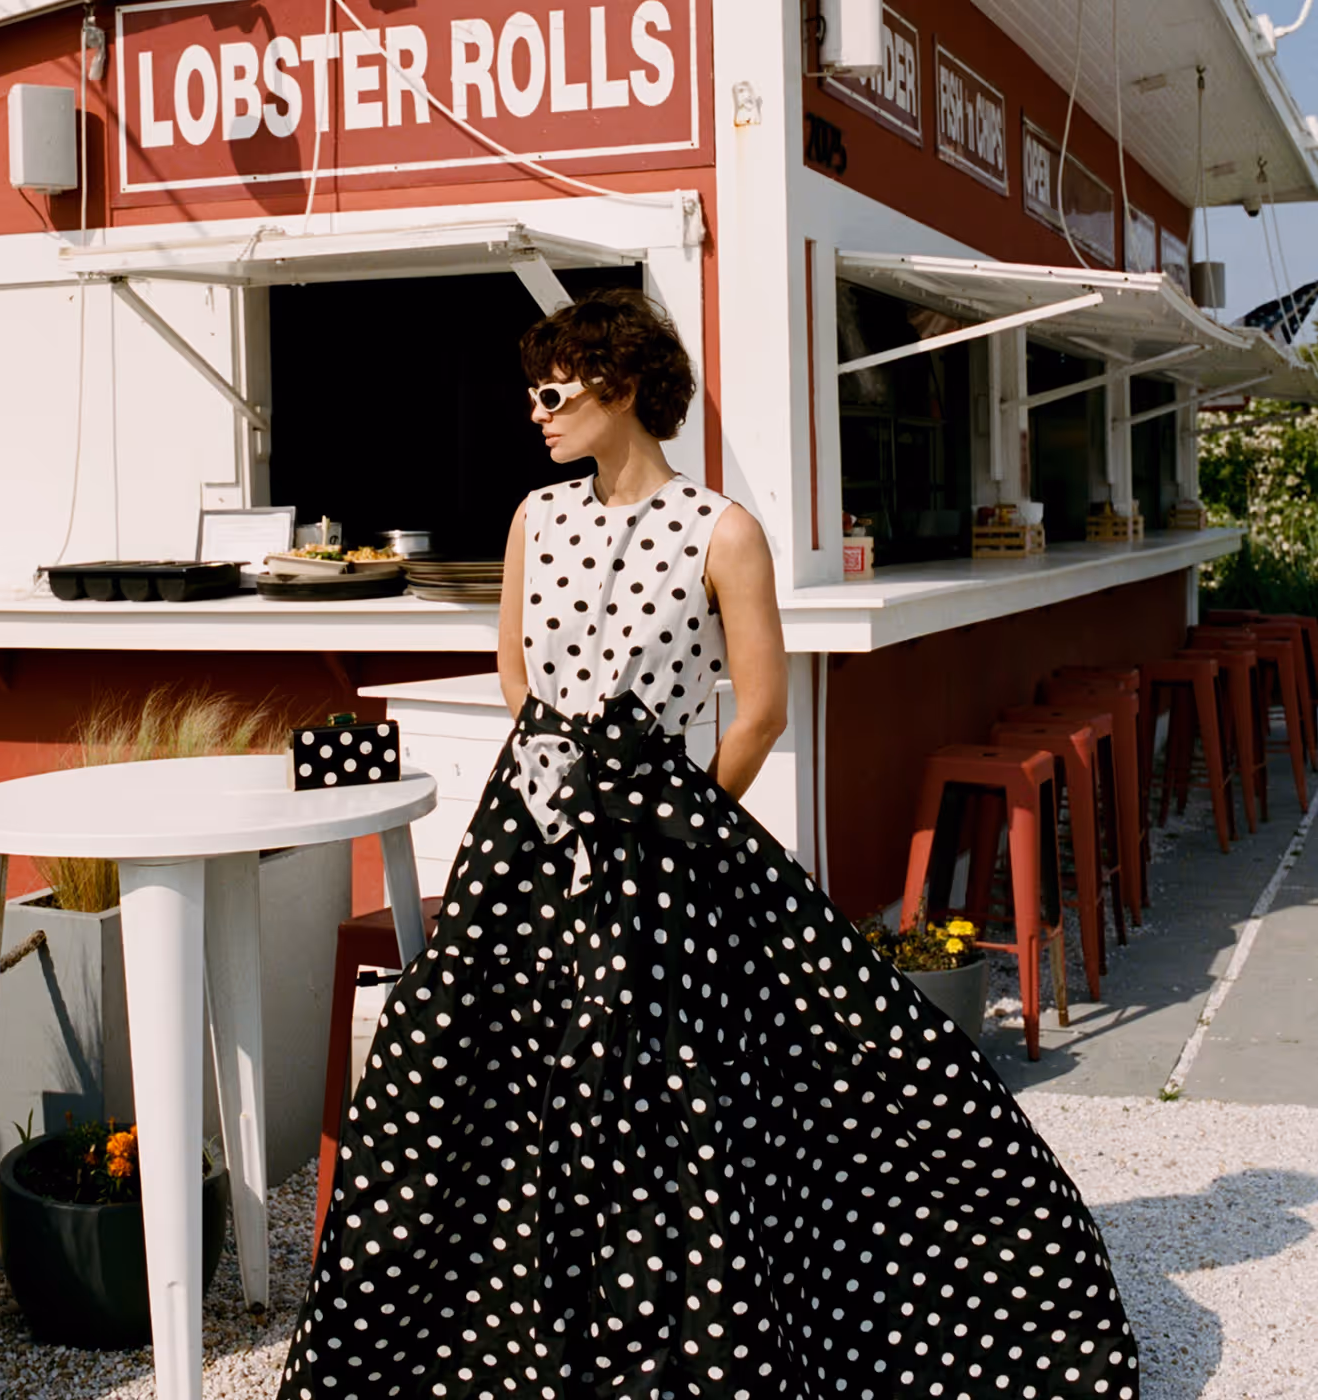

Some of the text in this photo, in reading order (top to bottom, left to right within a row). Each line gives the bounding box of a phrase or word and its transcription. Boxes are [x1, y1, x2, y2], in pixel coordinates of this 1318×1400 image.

[138, 0, 675, 147] LOBSTER ROLLS
[940, 64, 964, 145] FISH
[975, 92, 1004, 171] CHIPS
